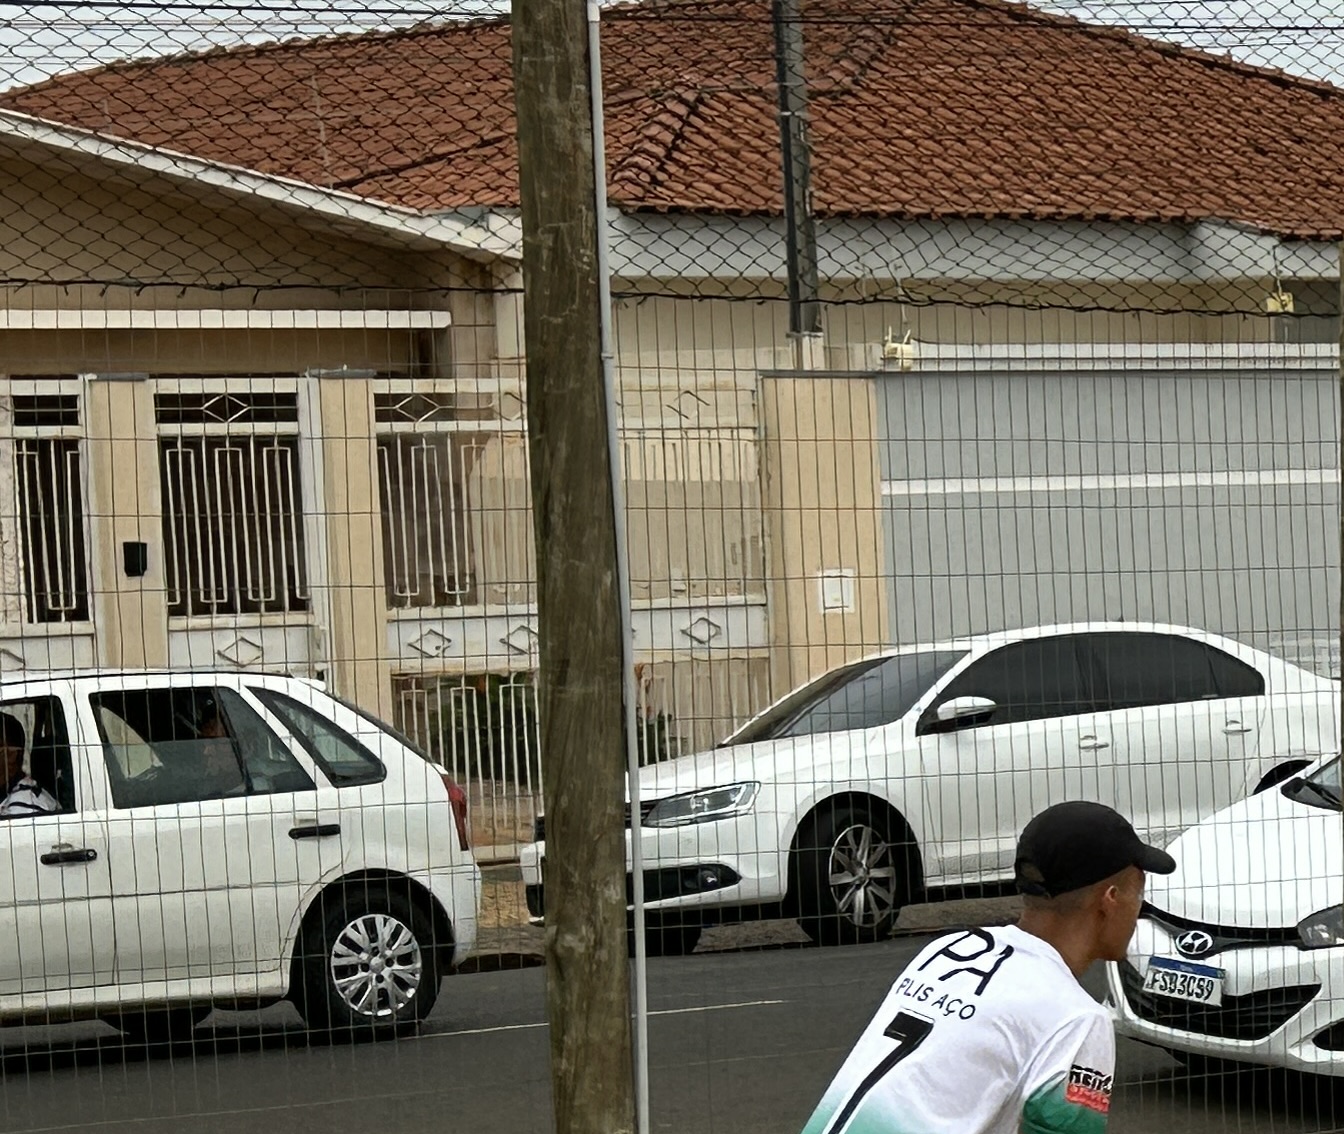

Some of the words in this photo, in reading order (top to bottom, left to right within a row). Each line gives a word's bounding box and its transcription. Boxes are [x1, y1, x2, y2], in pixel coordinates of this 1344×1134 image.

[917, 927, 1014, 996] PA
[895, 977, 935, 1002] PLIS
[930, 993, 977, 1020] AÇO
